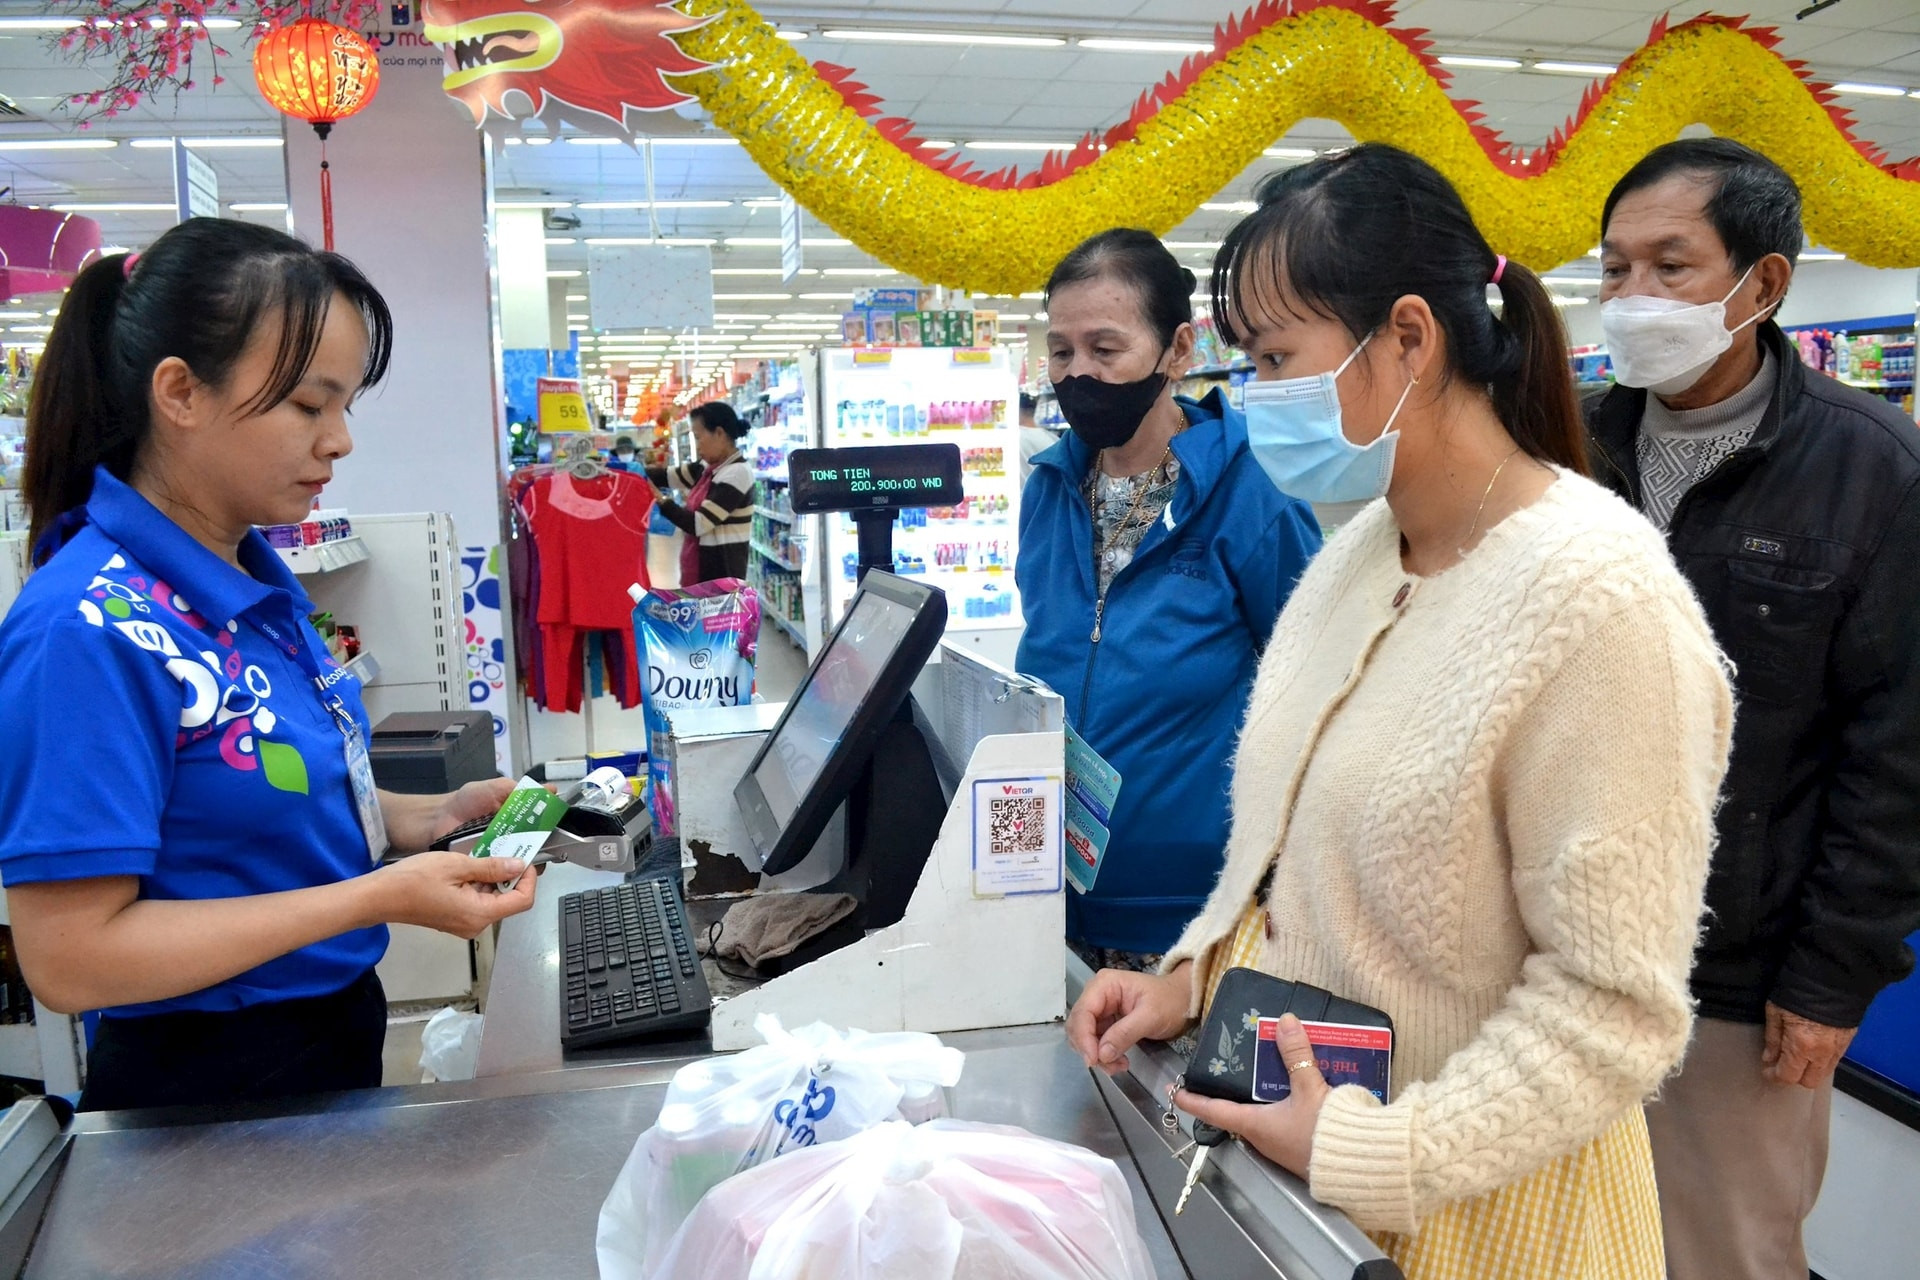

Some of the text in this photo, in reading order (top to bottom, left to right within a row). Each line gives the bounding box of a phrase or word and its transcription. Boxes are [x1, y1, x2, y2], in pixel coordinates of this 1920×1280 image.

[430, 56, 445, 66] nh
[810, 468, 871, 481] TONG TIEN
[922, 477, 942, 488] VND
[670, 604, 700, 622] 99%
[648, 665, 739, 708] Downy
[1002, 785, 1033, 795] VIETQR
